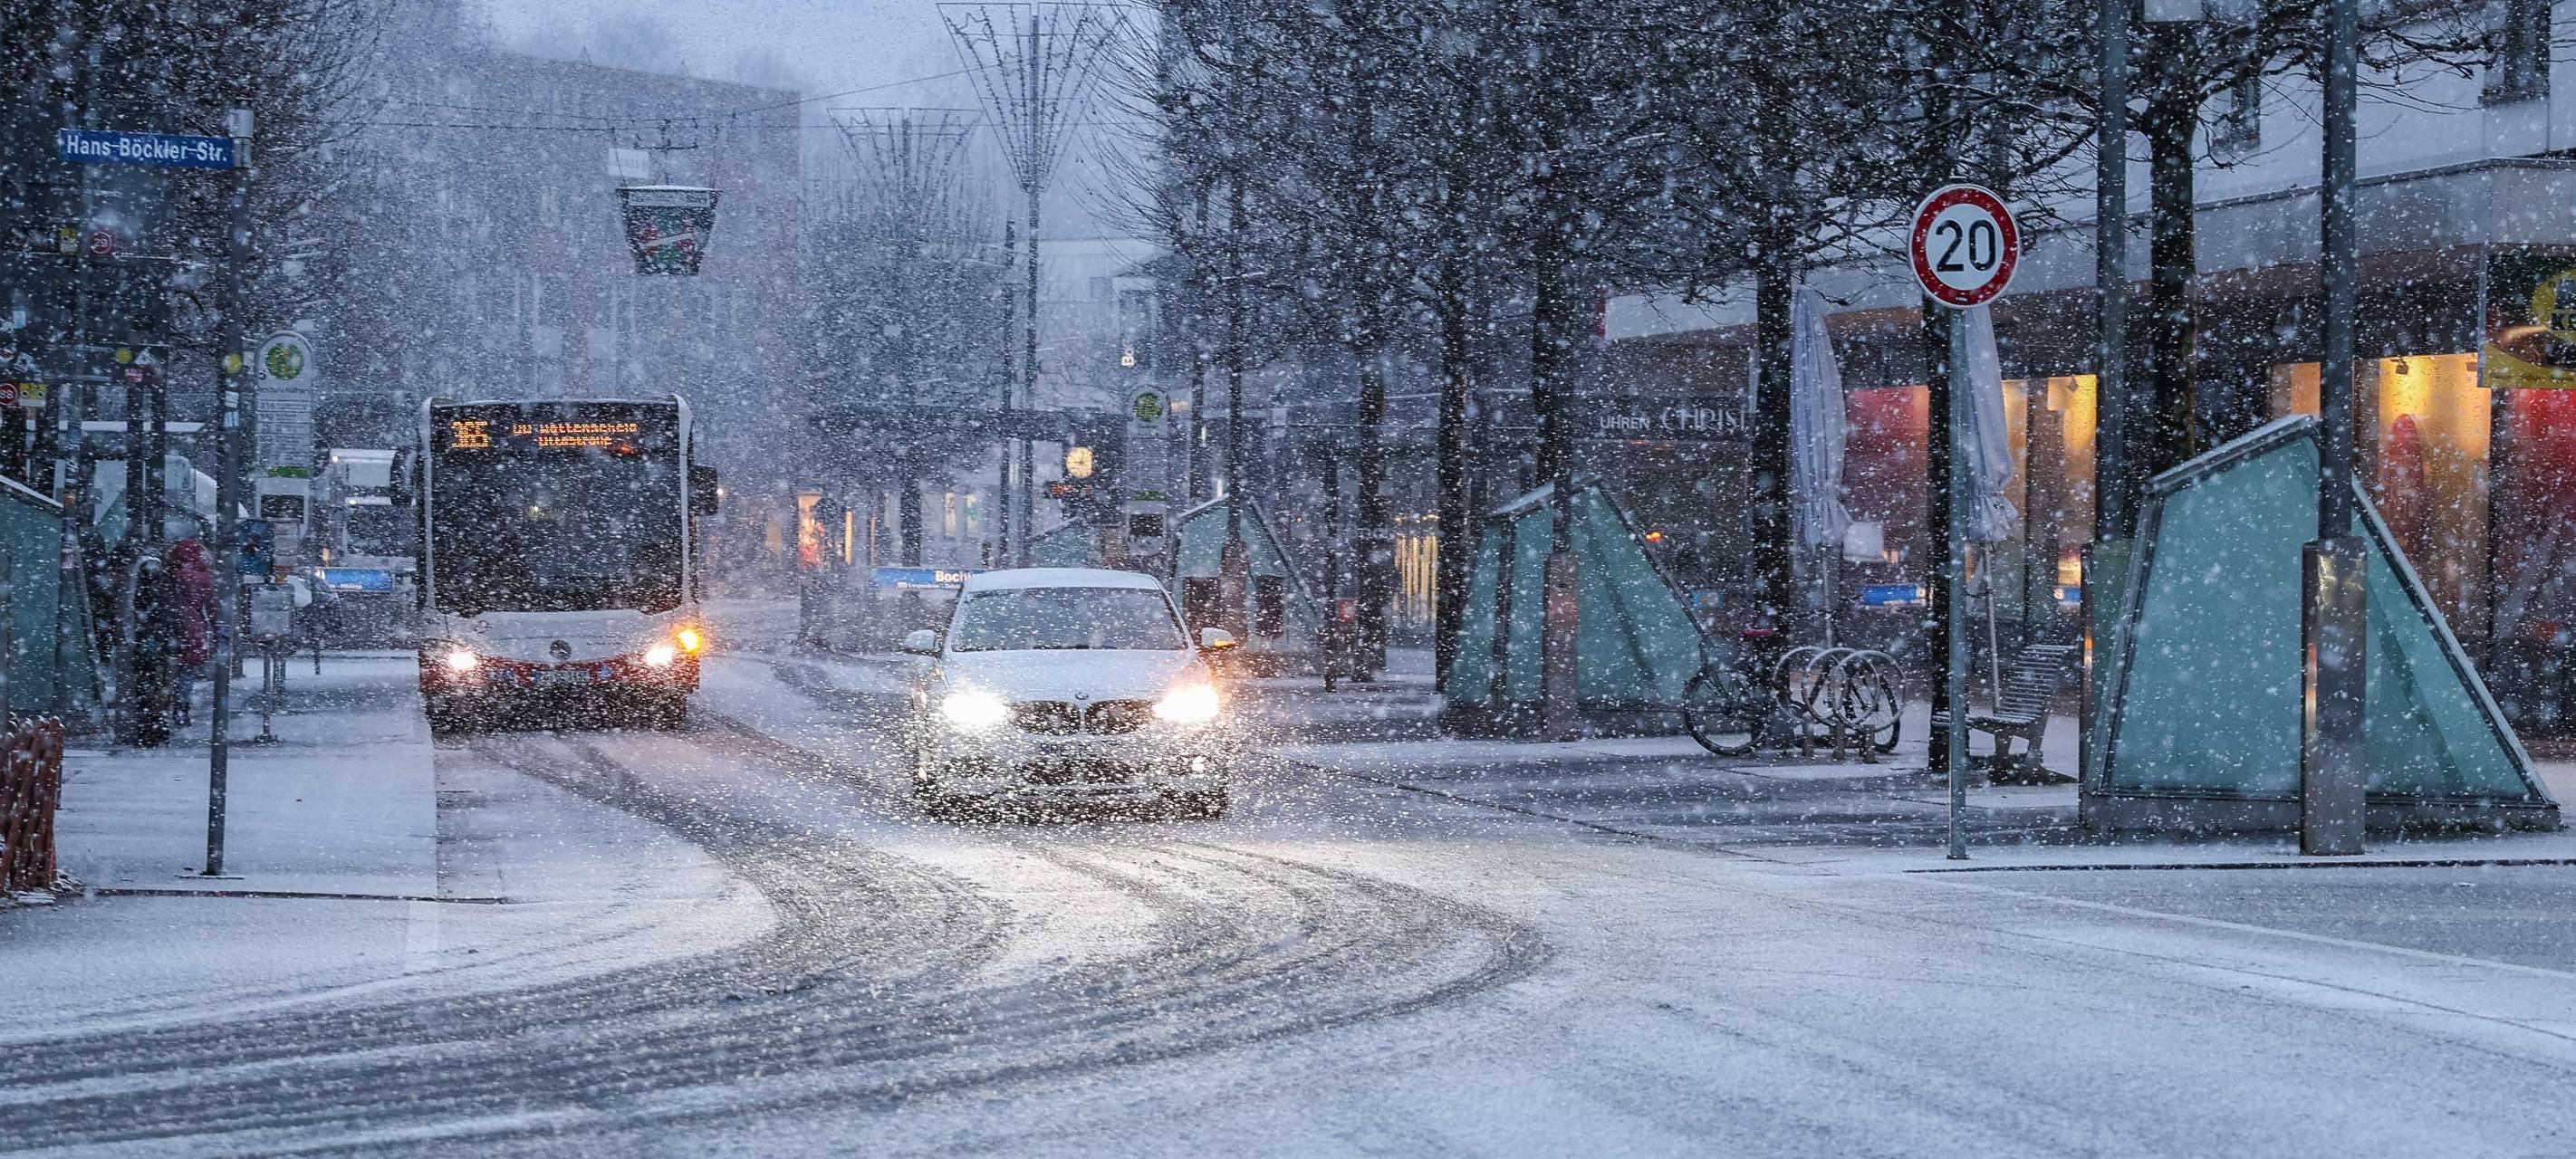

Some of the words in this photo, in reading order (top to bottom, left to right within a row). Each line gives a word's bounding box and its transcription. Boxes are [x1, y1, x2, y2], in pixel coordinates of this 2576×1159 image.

[66, 134, 227, 162] Hans-Böckler-Str.
[1936, 219, 1996, 272] 20
[1600, 416, 1650, 430] UHREN
